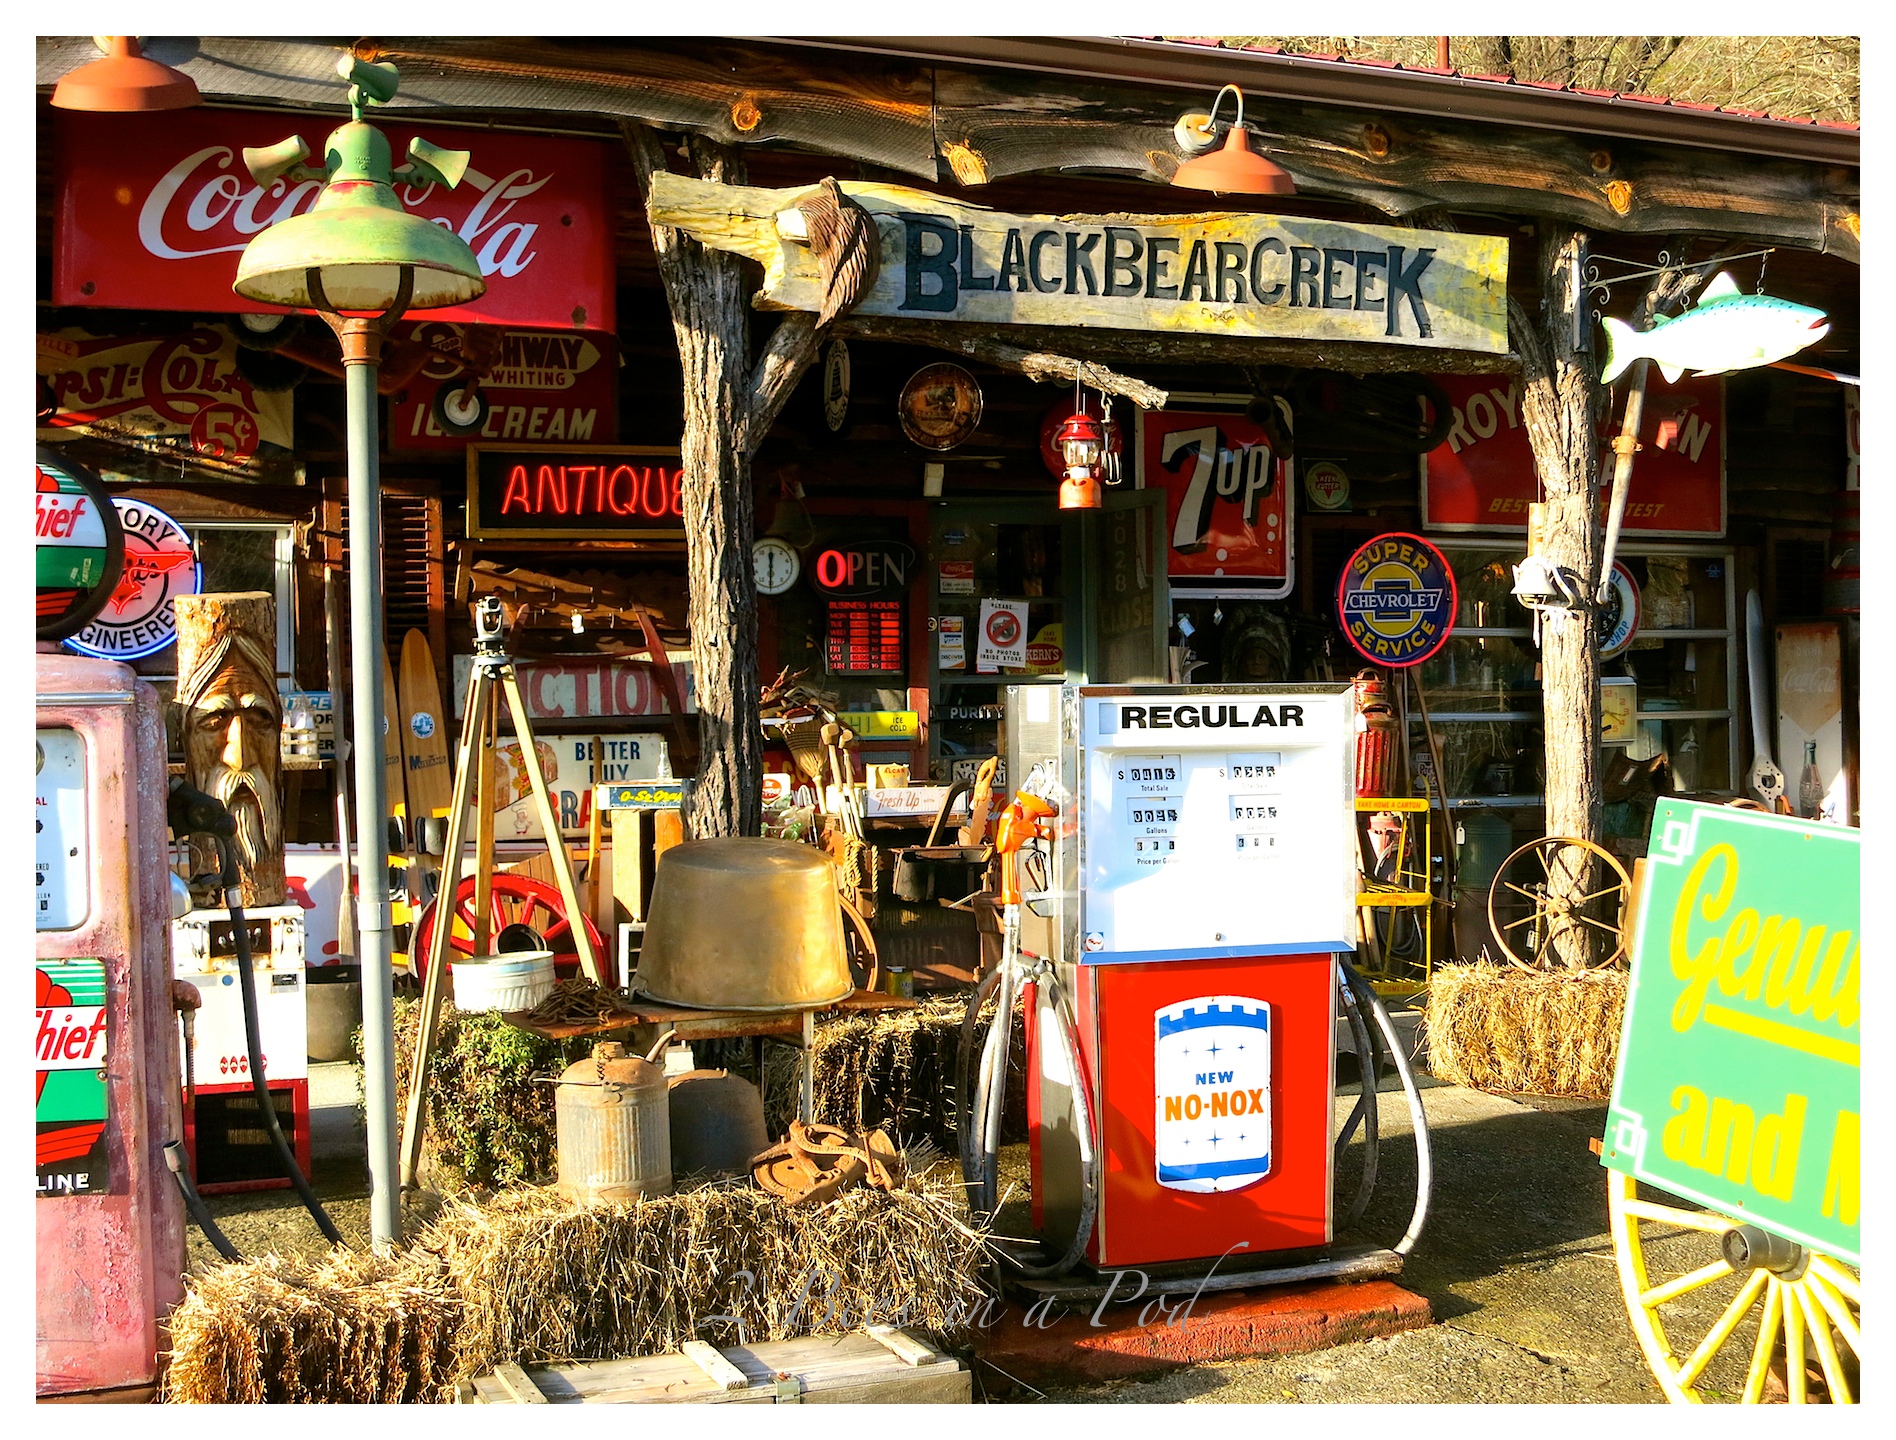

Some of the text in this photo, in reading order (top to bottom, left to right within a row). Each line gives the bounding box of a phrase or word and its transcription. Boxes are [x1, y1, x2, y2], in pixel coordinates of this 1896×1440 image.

[36, 336, 74, 354] VILLE
[490, 370, 566, 386] WHITING
[410, 402, 597, 441] IC CREAM
[1446, 383, 1522, 454] ROY
[36, 497, 86, 539] hief
[816, 549, 905, 588] OPEN
[1353, 541, 1430, 575] SUPER
[828, 601, 900, 610] BUSINESS HOURS
[1348, 593, 1438, 609] CHEVROLET
[79, 599, 175, 651] GINEERED
[1350, 619, 1437, 657] SERVICE
[1610, 620, 1630, 647] SHOP
[1026, 648, 1060, 661] KERN'S
[889, 724, 907, 732] COLD
[1121, 705, 1304, 729] REGULAR
[575, 741, 640, 761] BETER
[652, 790, 683, 804] Grap
[1670, 842, 1860, 1033] Genu
[36, 1007, 107, 1061] hief
[1195, 1070, 1234, 1086] NEW
[1165, 1088, 1264, 1122] NO-NOX
[1662, 1085, 1808, 1202] and
[36, 1173, 89, 1190] LINE
